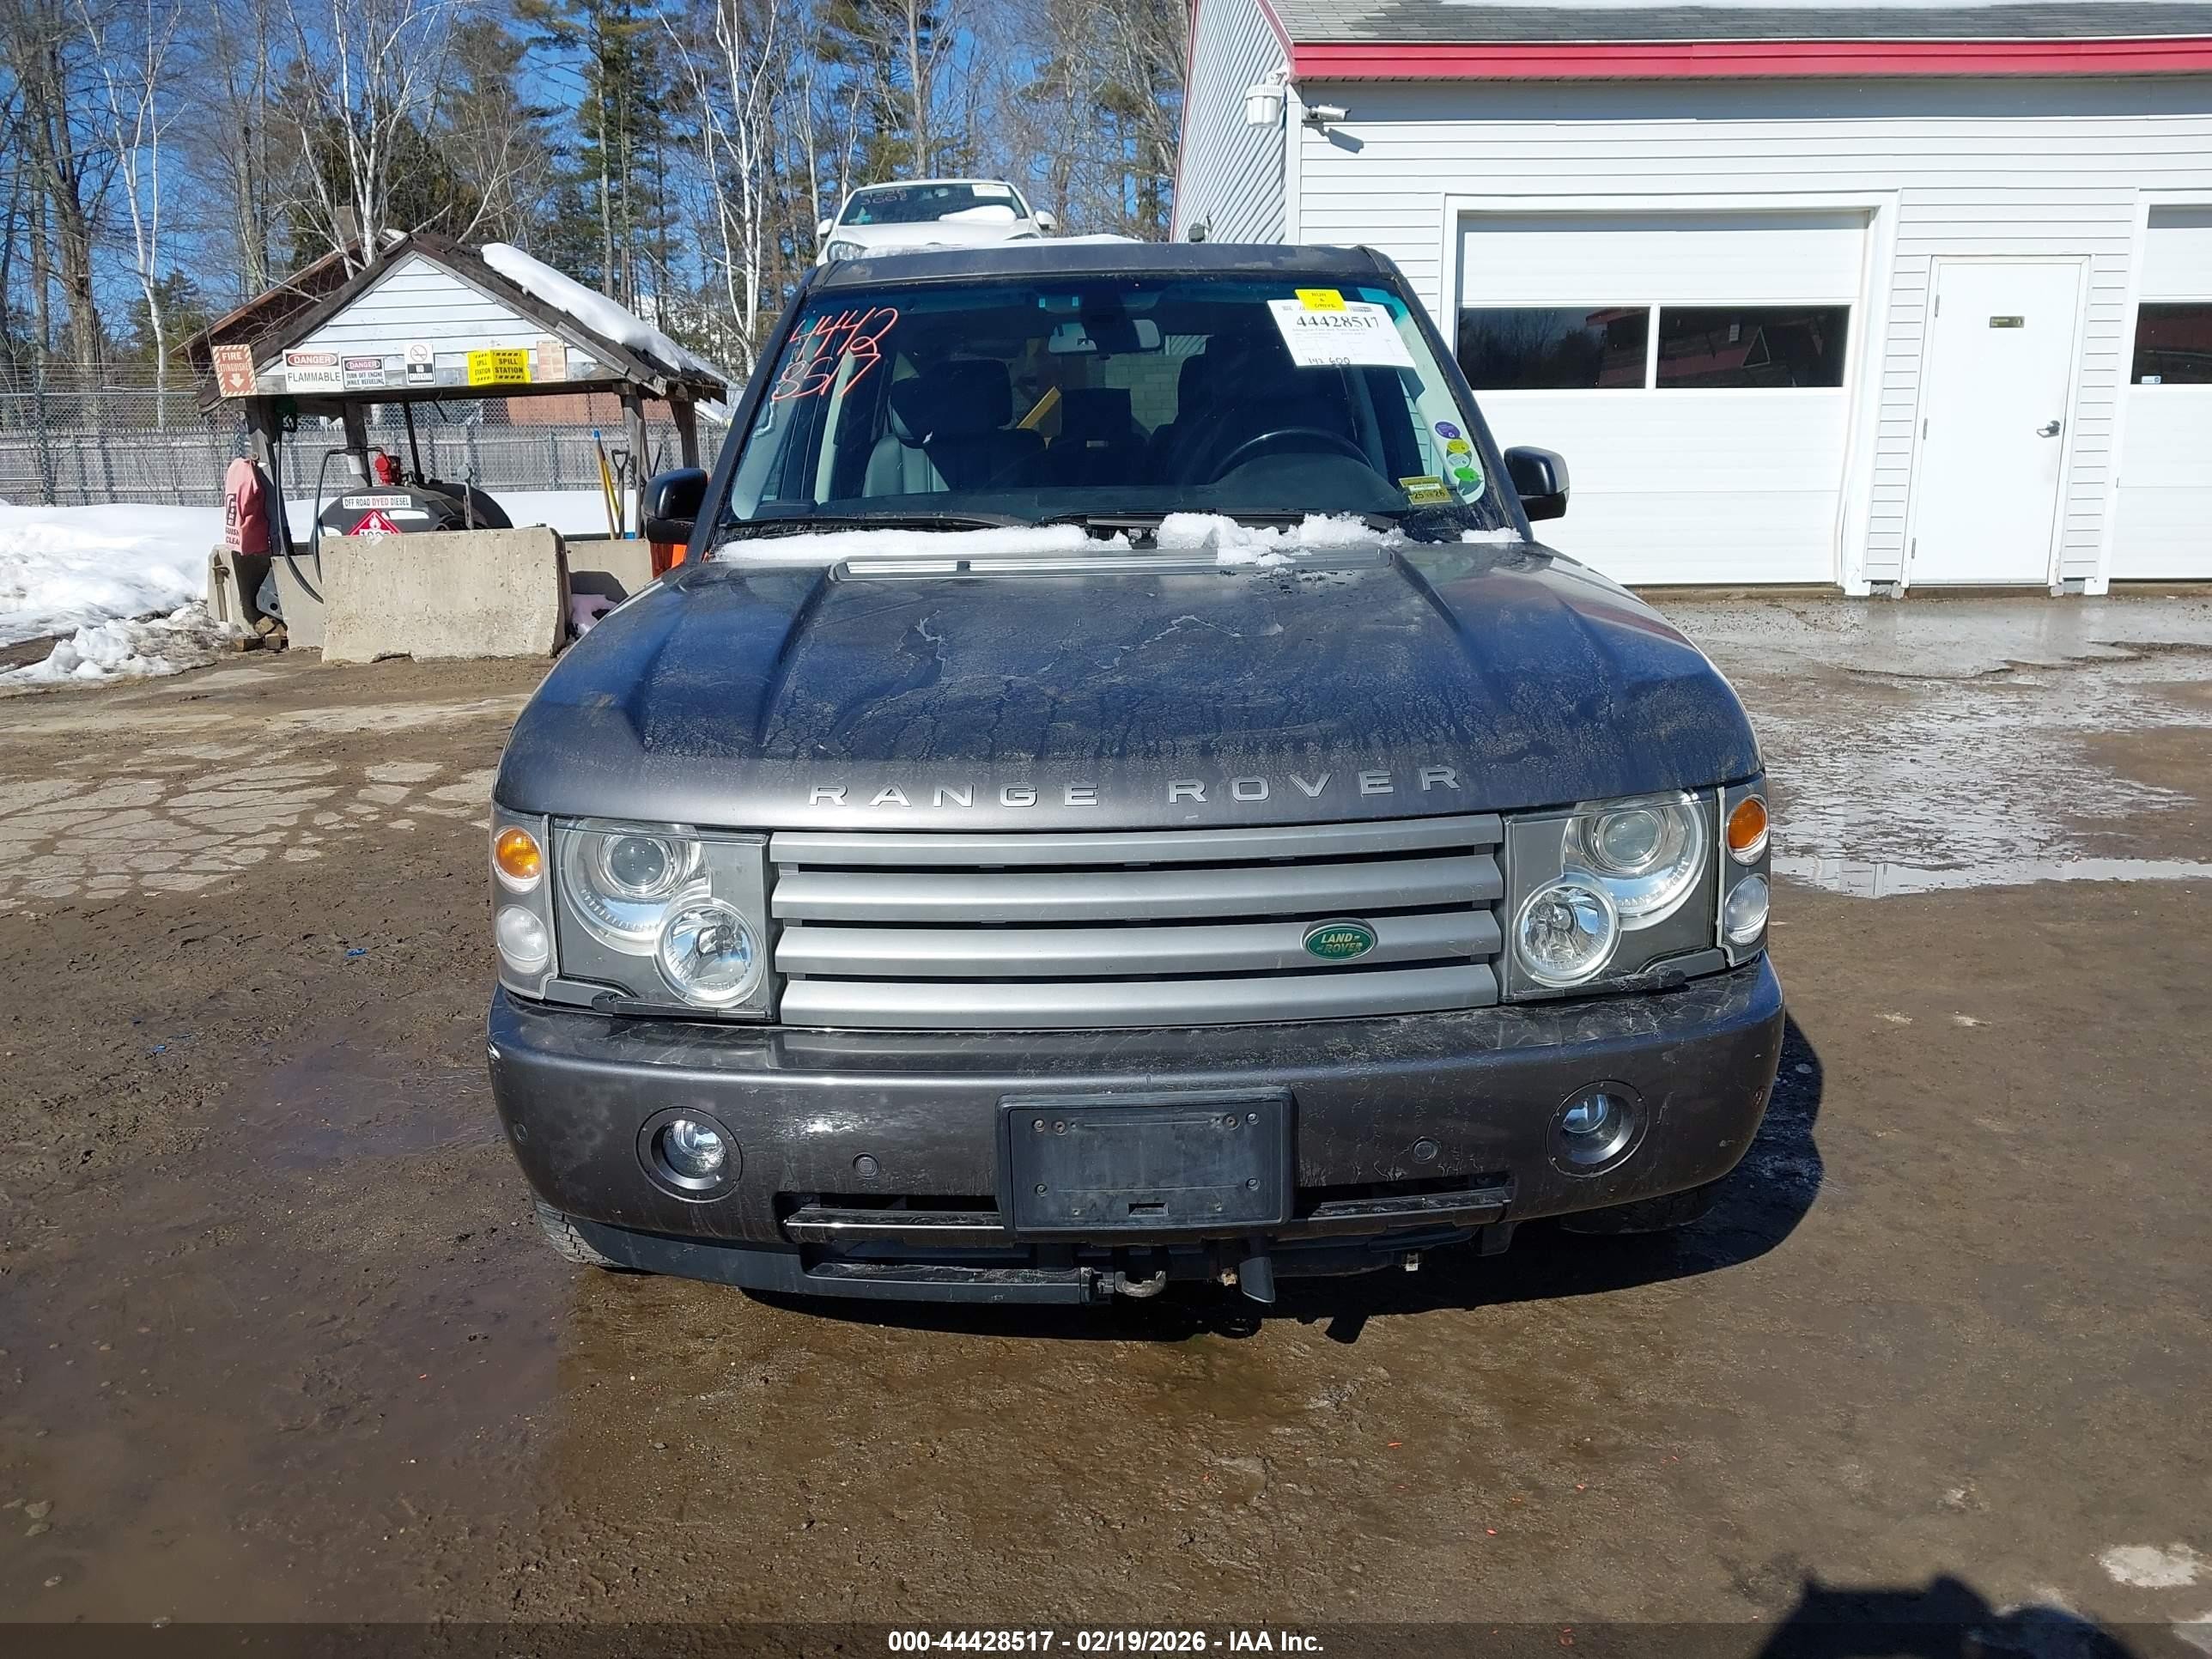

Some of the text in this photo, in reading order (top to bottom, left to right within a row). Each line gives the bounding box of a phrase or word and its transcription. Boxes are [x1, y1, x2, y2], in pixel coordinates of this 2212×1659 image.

[1296, 315, 1379, 328] 44428517
[789, 307, 898, 362] 4442
[222, 351, 243, 361] FIRE
[294, 356, 331, 364] DANGER
[216, 362, 252, 373] EXTINGUISHER
[349, 361, 378, 369] DANGER
[288, 372, 341, 382] FLAMMABLE
[772, 353, 882, 400] 8517
[344, 497, 410, 507] OFF ROAD DYED DIESEL
[809, 765, 1461, 807] RANGE ROVER
